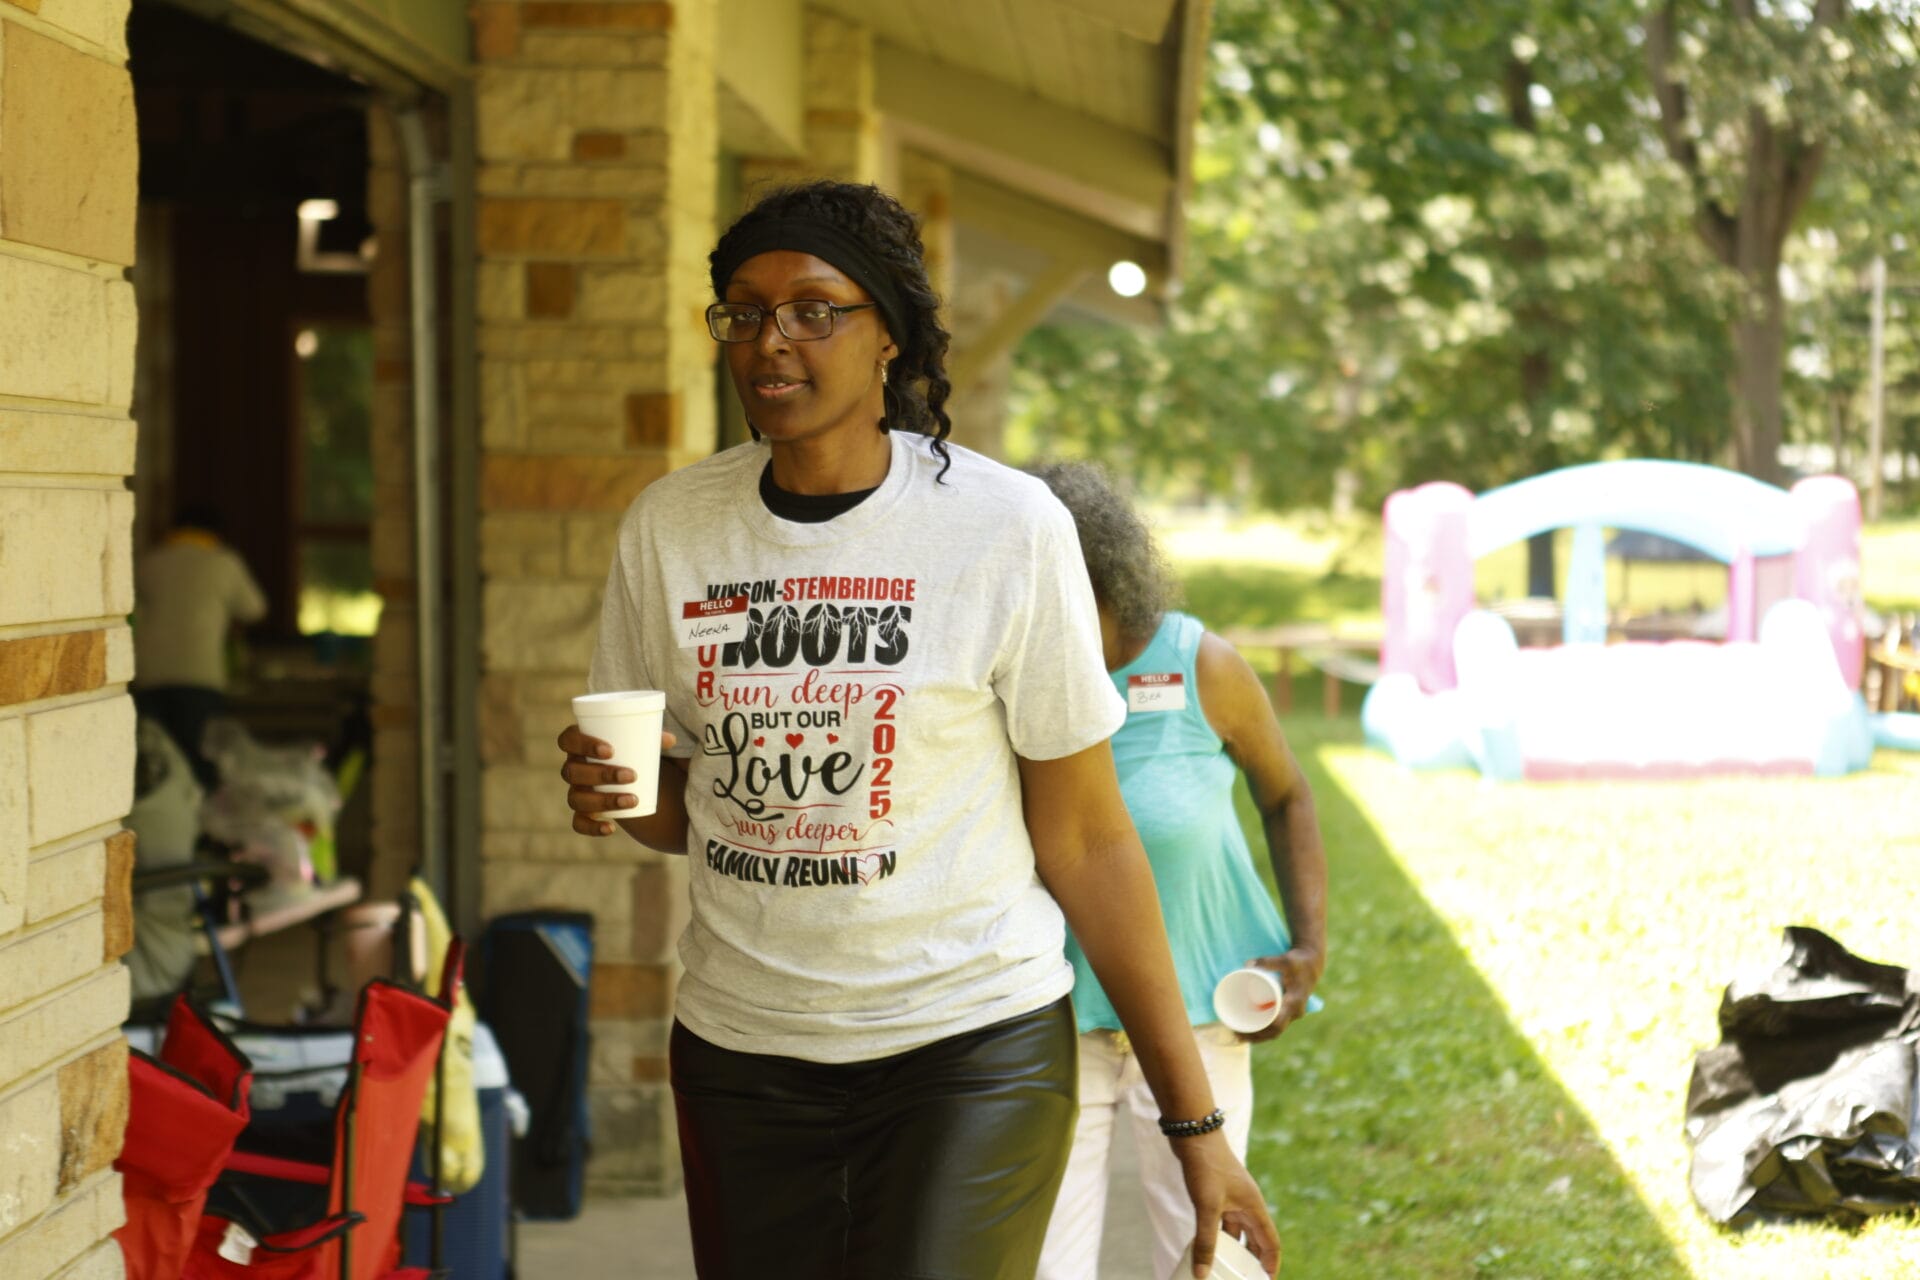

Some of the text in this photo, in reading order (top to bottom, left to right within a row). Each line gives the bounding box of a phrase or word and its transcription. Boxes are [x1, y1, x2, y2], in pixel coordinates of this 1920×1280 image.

[699, 599, 733, 611] HELLO
[707, 576, 916, 603] VINSON-STEMBRIDGE
[722, 602, 912, 668] ROOTS
[696, 644, 717, 699] UR
[696, 668, 905, 720] run deep
[1140, 674, 1171, 683] HELLO
[751, 710, 841, 730] BUT OUR
[703, 711, 865, 822] Love
[869, 688, 898, 820] 2025
[716, 812, 894, 853] runs deeper
[706, 838, 781, 886] FAMILY
